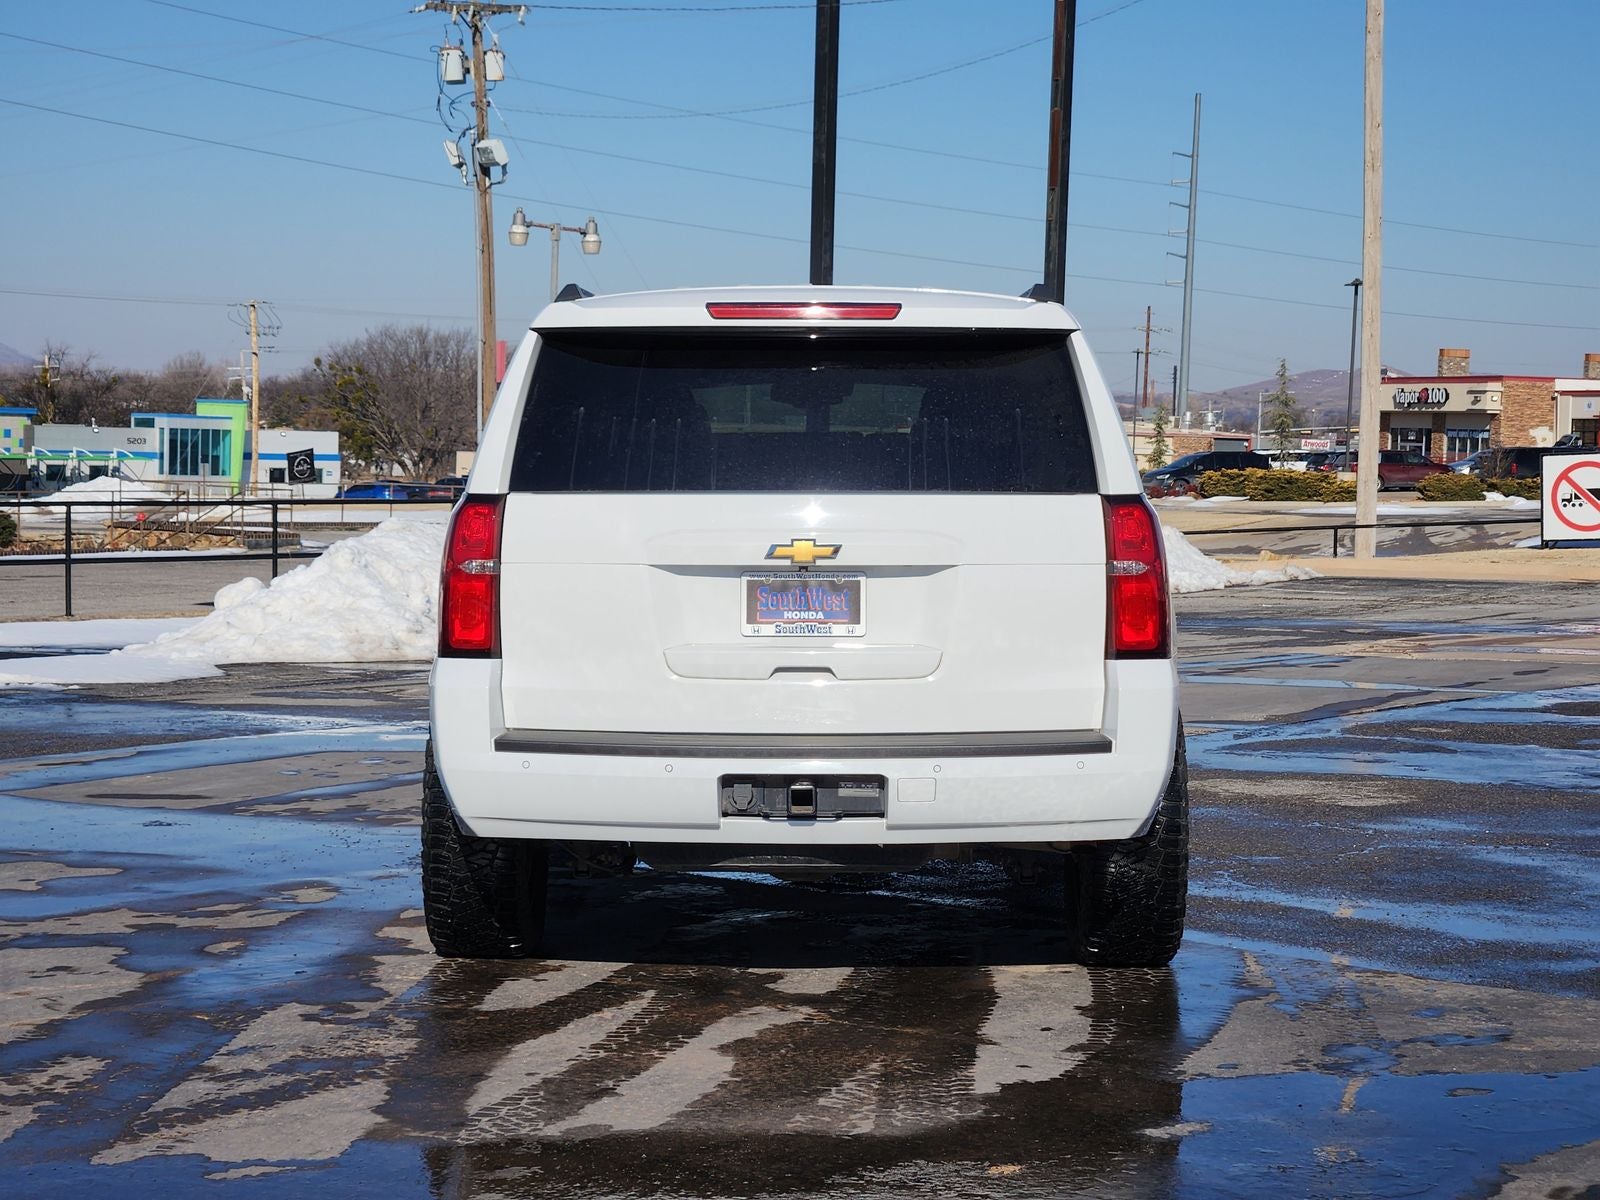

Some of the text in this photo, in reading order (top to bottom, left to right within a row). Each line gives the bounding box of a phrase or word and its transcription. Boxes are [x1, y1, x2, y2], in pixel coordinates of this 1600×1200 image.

[1395, 388, 1446, 407] Vapor 100
[126, 437, 147, 445] 5203
[783, 611, 825, 620] HONDA
